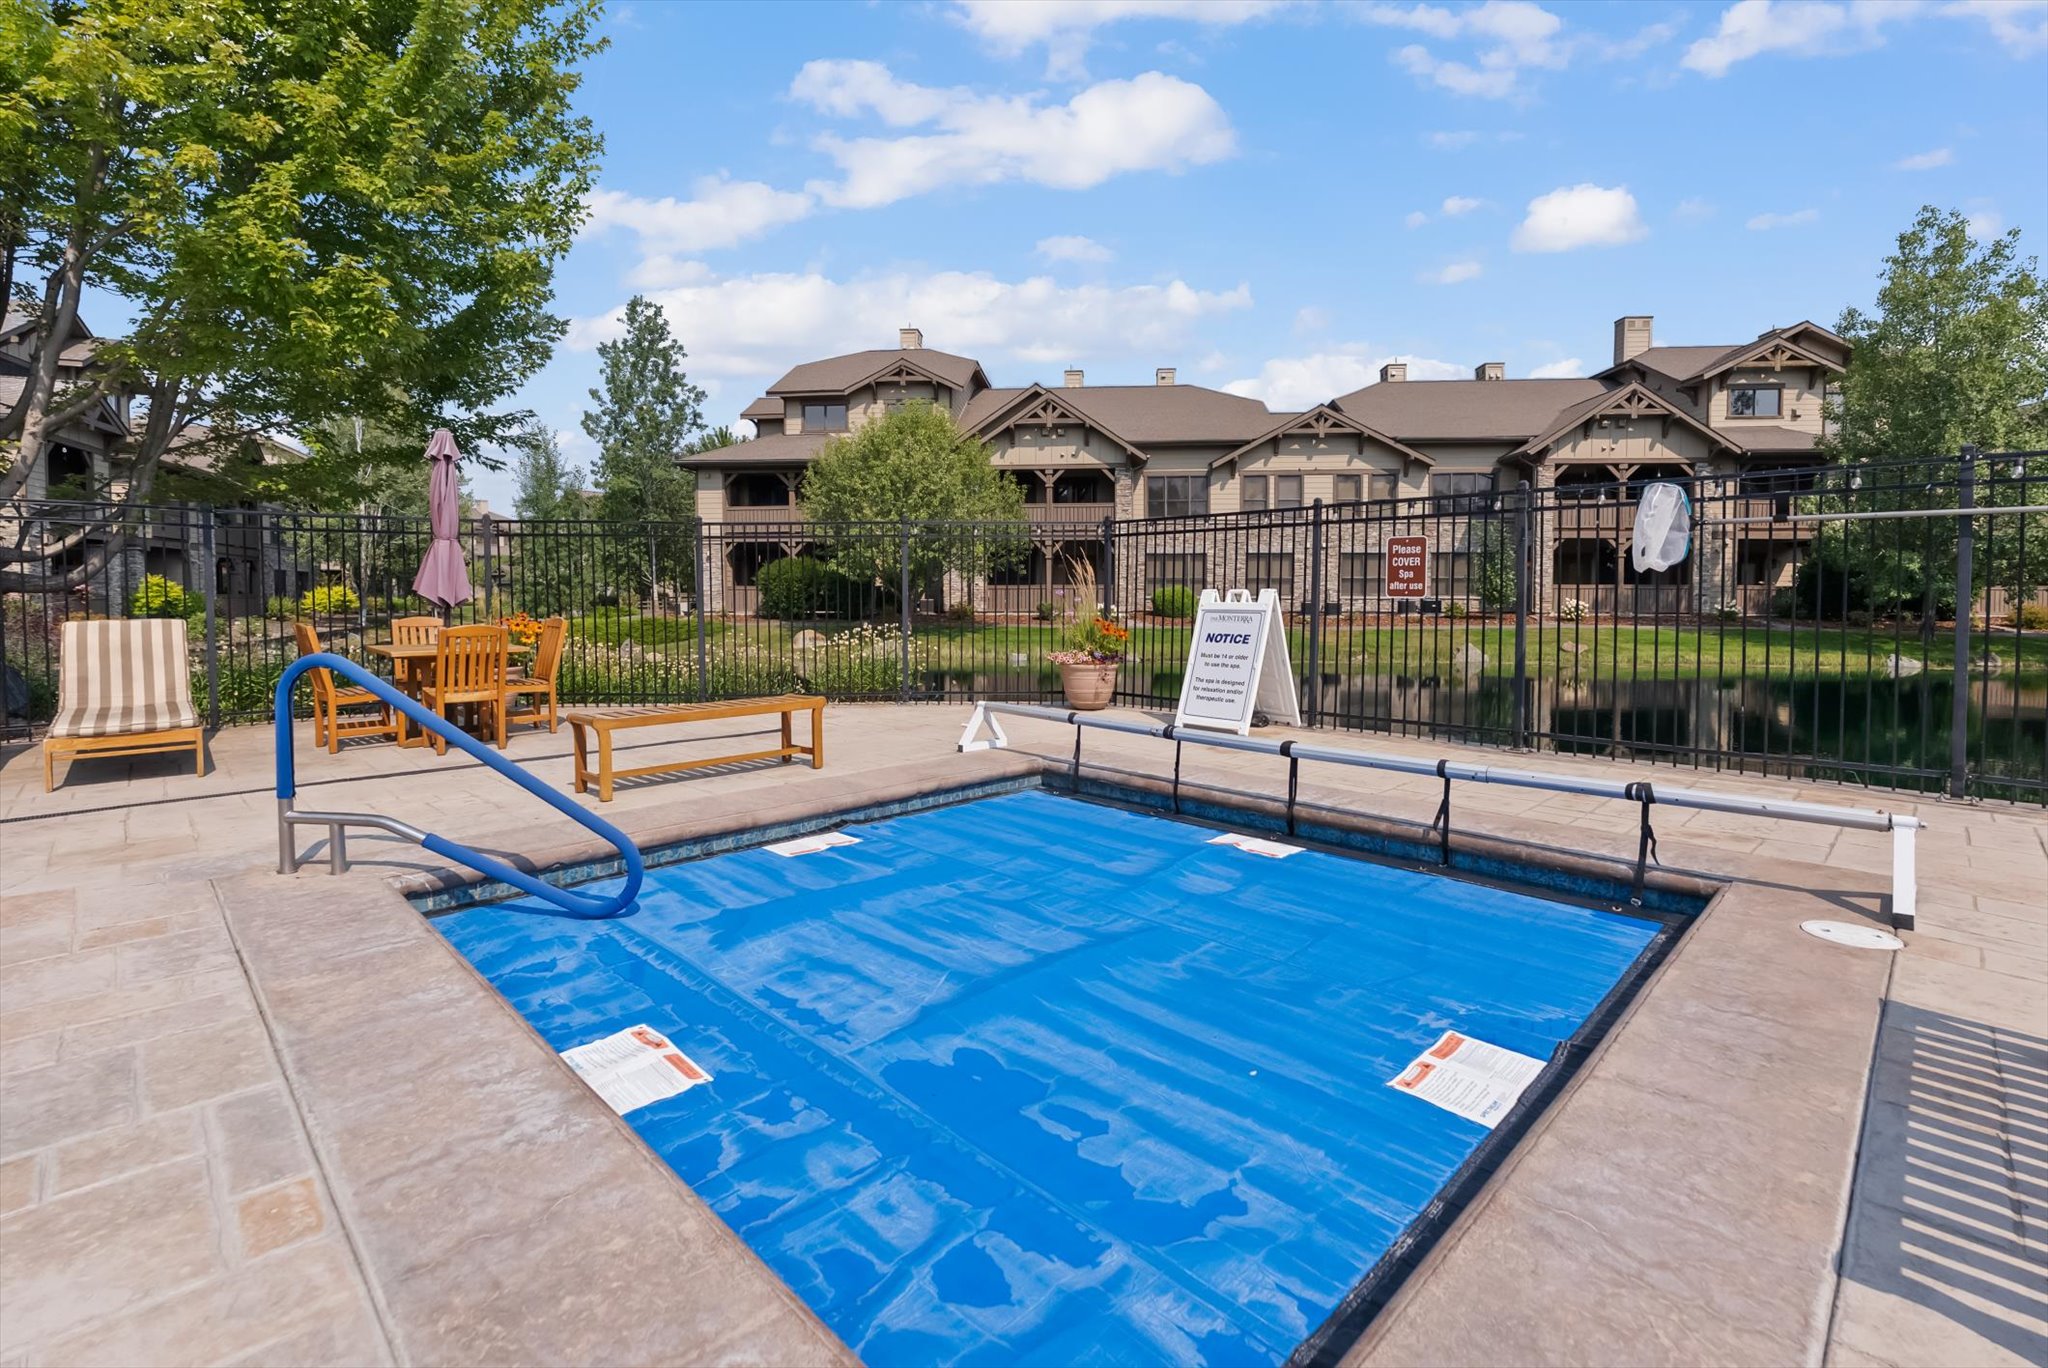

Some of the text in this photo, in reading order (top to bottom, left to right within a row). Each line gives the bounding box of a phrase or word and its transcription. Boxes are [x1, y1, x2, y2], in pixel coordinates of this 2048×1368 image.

[1392, 545, 1422, 554] Please
[1392, 557, 1421, 567] COVER
[1398, 569, 1414, 580] Spa
[1389, 581, 1423, 590] after use
[1218, 615, 1253, 624] MONTERRA
[1205, 632, 1251, 645] NOTICE
[1221, 679, 1245, 687] designed
[1196, 694, 1224, 702] therapeutic
